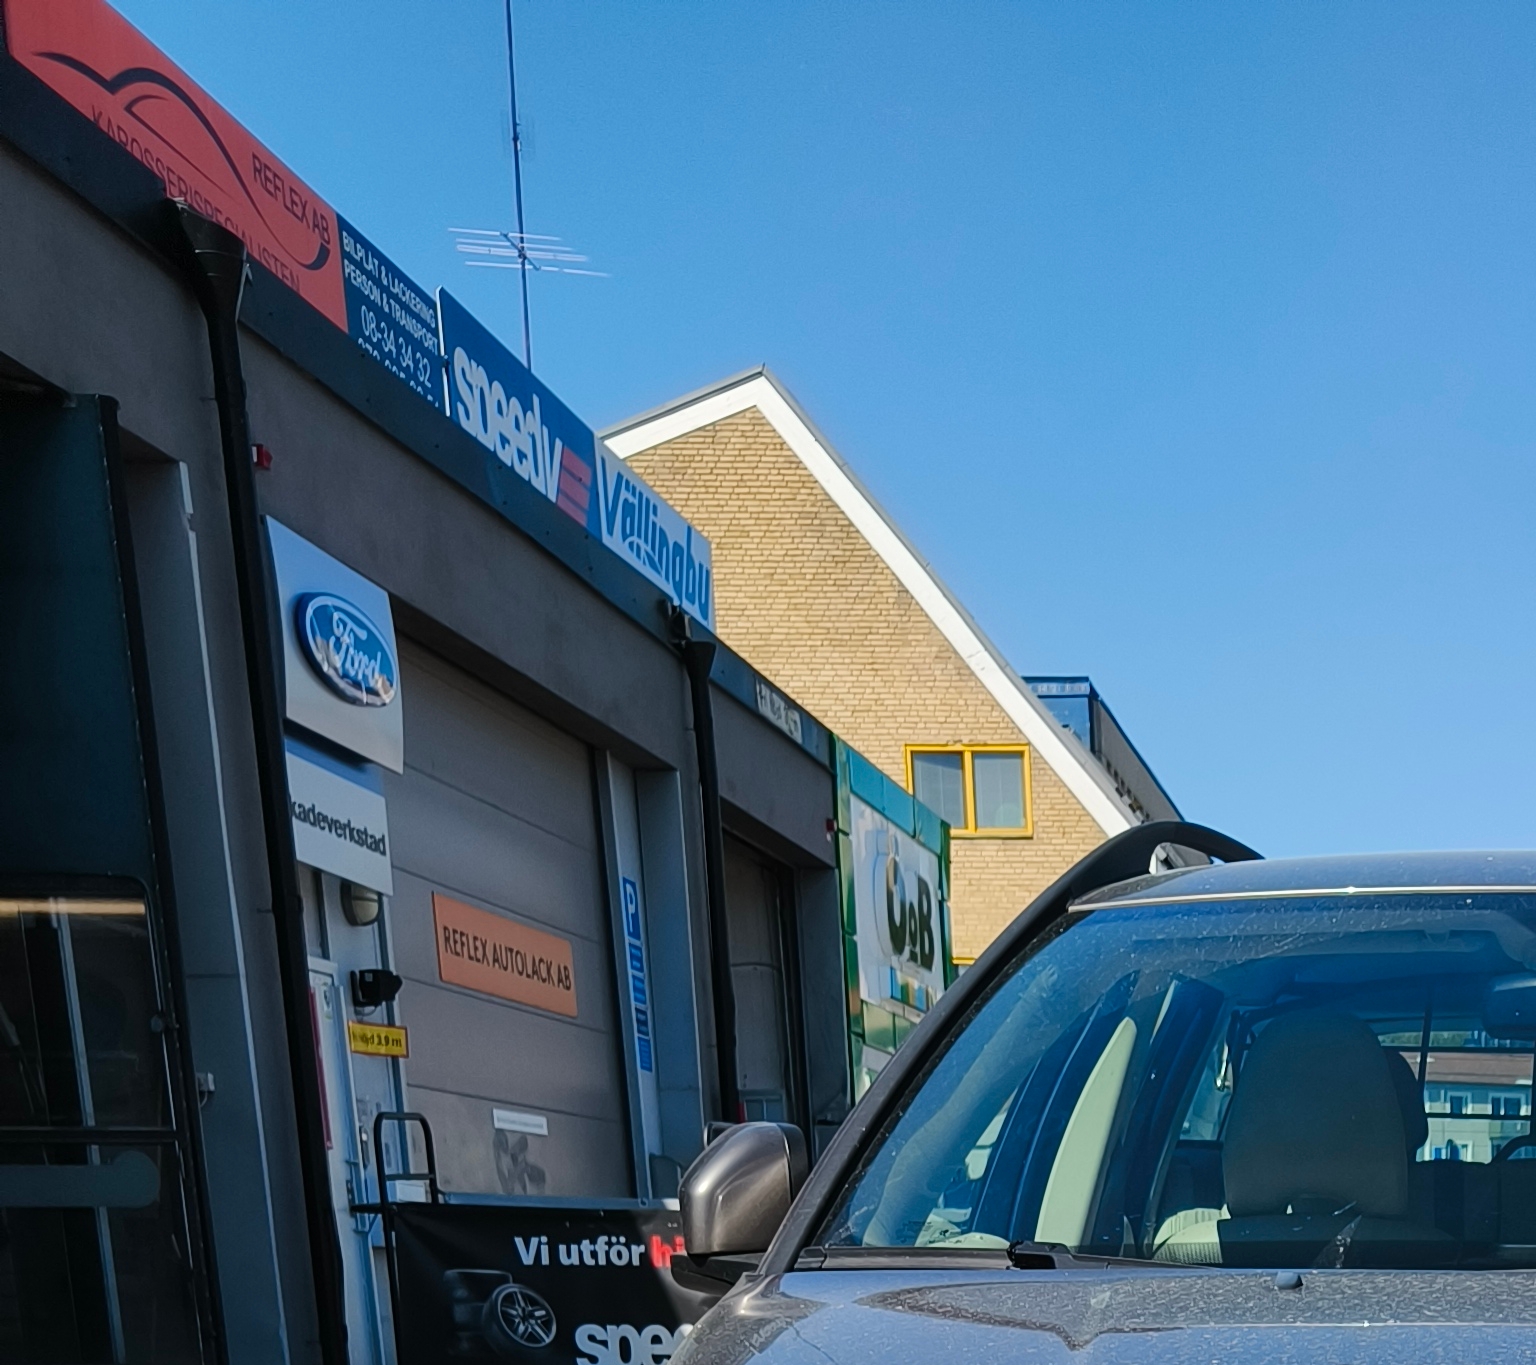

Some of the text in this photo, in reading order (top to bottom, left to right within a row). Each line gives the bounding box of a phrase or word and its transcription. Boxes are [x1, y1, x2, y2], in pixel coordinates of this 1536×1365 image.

[252, 152, 331, 245] REFLEX AB
[342, 230, 436, 329] BILPLAT & LACKERING
[343, 259, 381, 308] PERSON
[382, 293, 390, 314] &
[389, 299, 439, 356] TRANSPORT
[361, 305, 397, 359] 08-34
[399, 337, 414, 374] 34
[416, 351, 432, 388] 32
[329, 609, 384, 684] Ford
[442, 925, 573, 992] REFLEX AUTOLACK AB
[513, 1235, 550, 1266] Vi
[558, 1235, 646, 1266] utför
